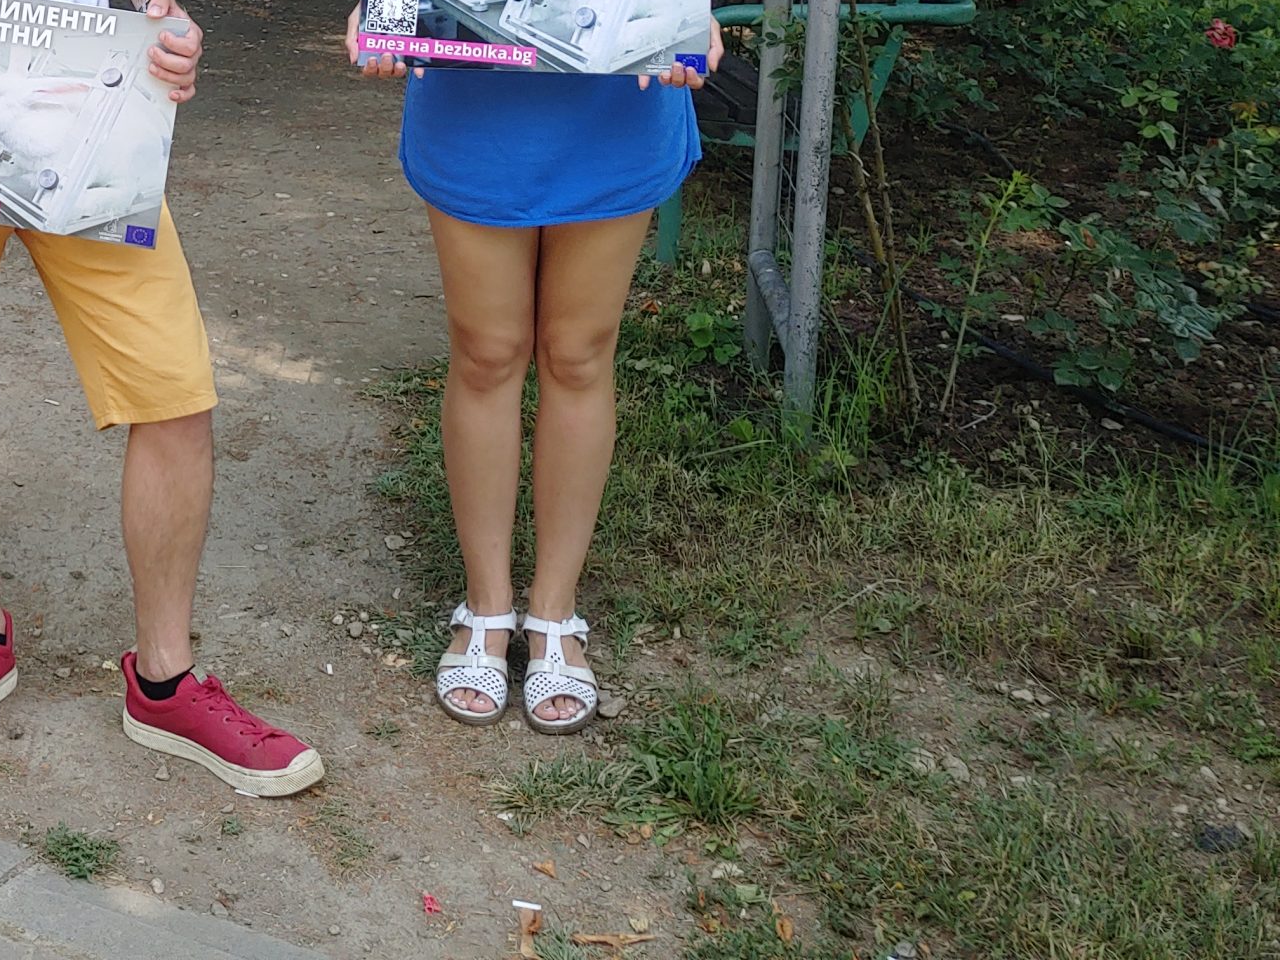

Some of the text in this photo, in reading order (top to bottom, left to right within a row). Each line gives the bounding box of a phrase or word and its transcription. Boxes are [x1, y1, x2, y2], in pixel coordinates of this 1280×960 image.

[366, 37, 532, 65] влез на bezbolka.bg
